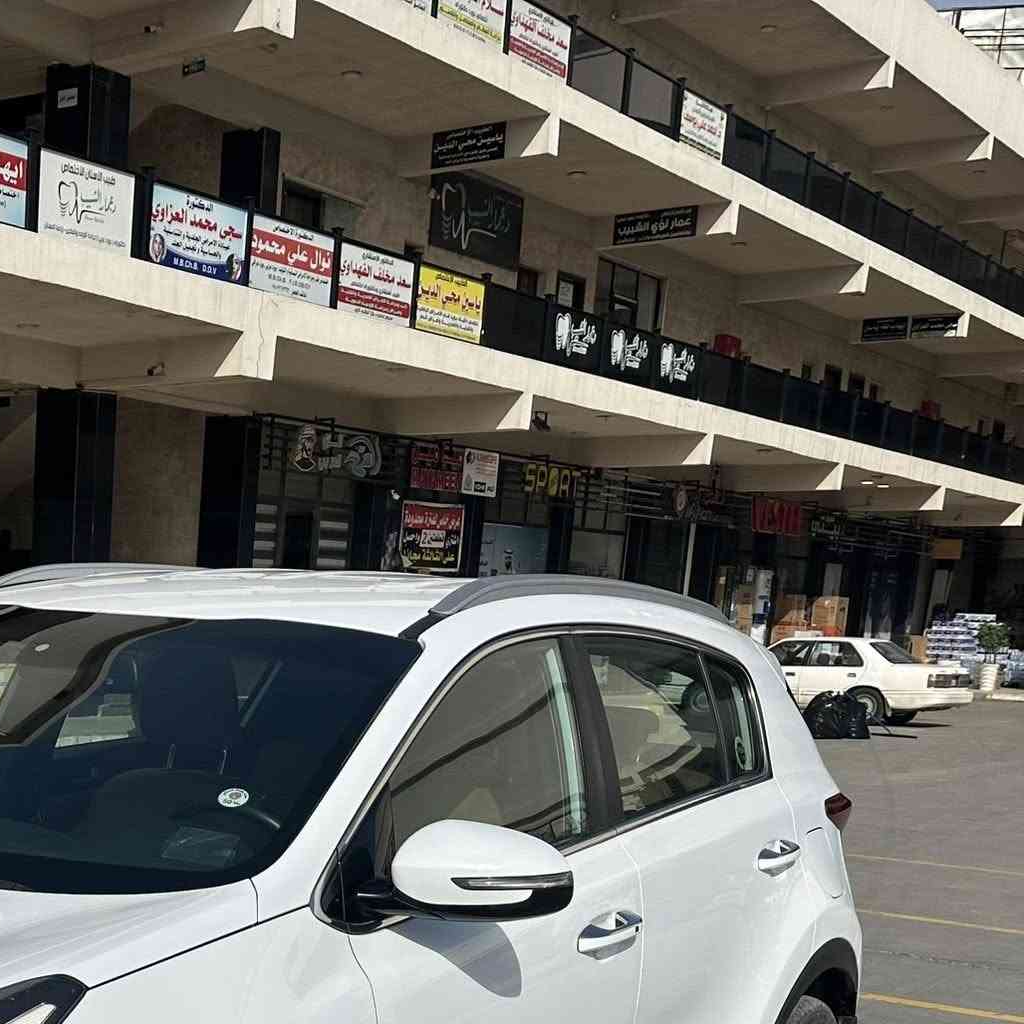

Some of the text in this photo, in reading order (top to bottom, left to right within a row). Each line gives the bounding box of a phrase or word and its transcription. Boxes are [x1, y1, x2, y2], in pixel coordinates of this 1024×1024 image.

[186, 195, 213, 212] الدكتورة
[151, 203, 187, 224] العزاوي
[189, 215, 217, 231] محمد
[251, 234, 330, 271] نوال علي محمود
